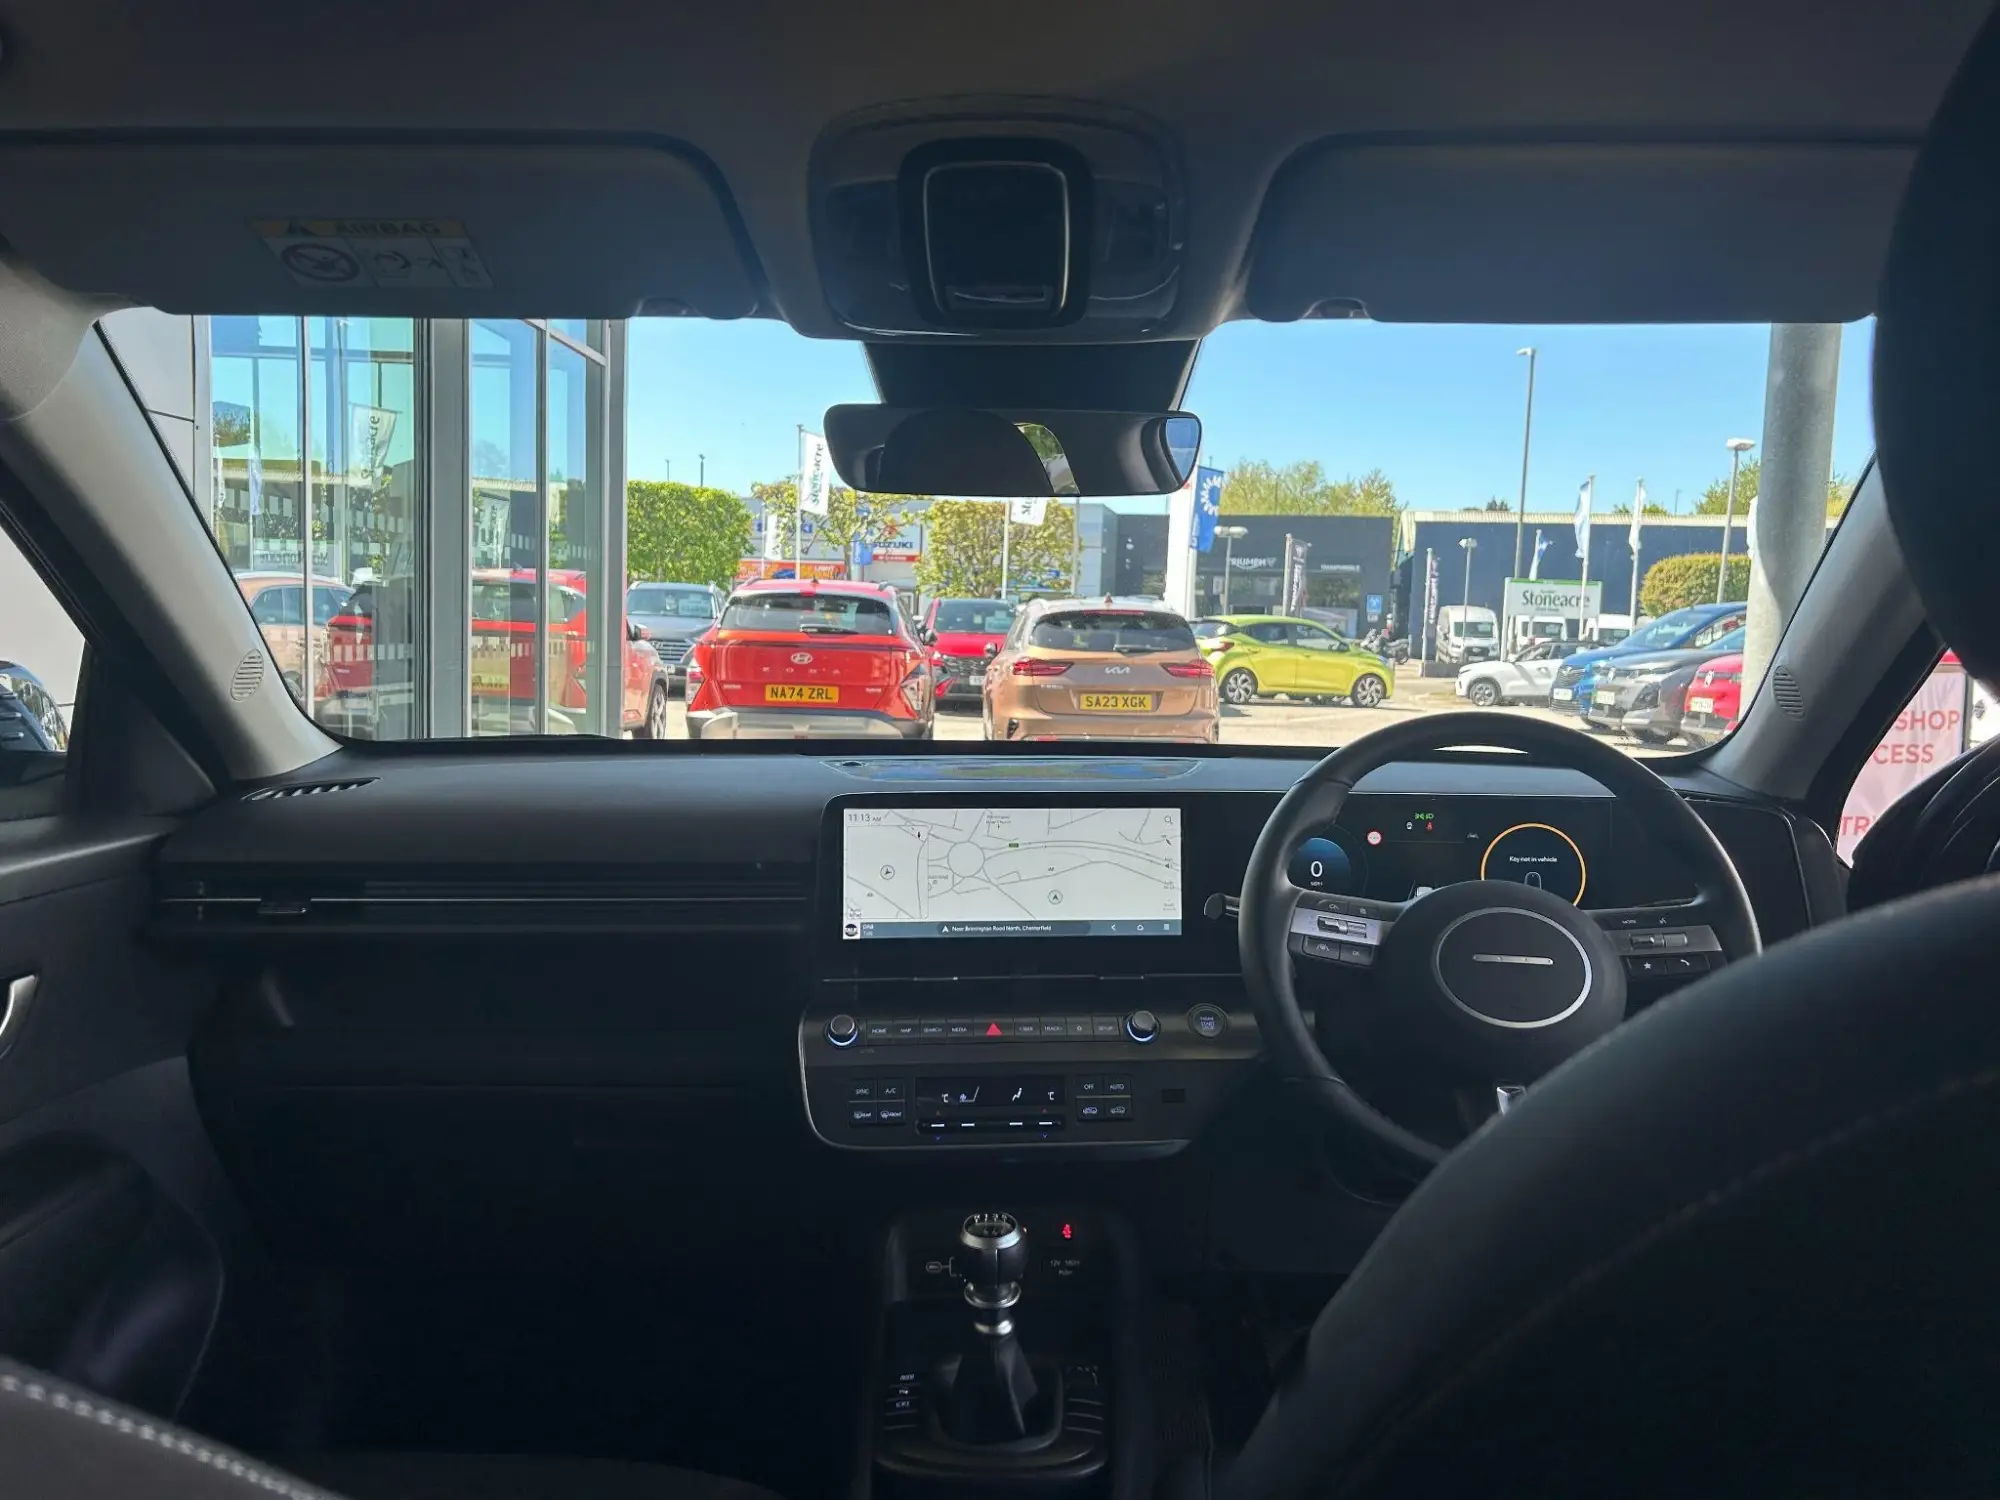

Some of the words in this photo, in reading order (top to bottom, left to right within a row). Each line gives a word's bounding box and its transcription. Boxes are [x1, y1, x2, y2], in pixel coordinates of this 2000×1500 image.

[336, 220, 440, 234] AIRBAG
[1521, 590, 1590, 606] Stoneacre
[770, 687, 804, 699] NA74
[808, 688, 833, 700] ZRL
[1086, 696, 1118, 708] SA23
[1121, 696, 1146, 708] XGK
[1895, 710, 1960, 731] SHOP
[1841, 815, 1877, 836] TR
[1310, 860, 1323, 877] 0
